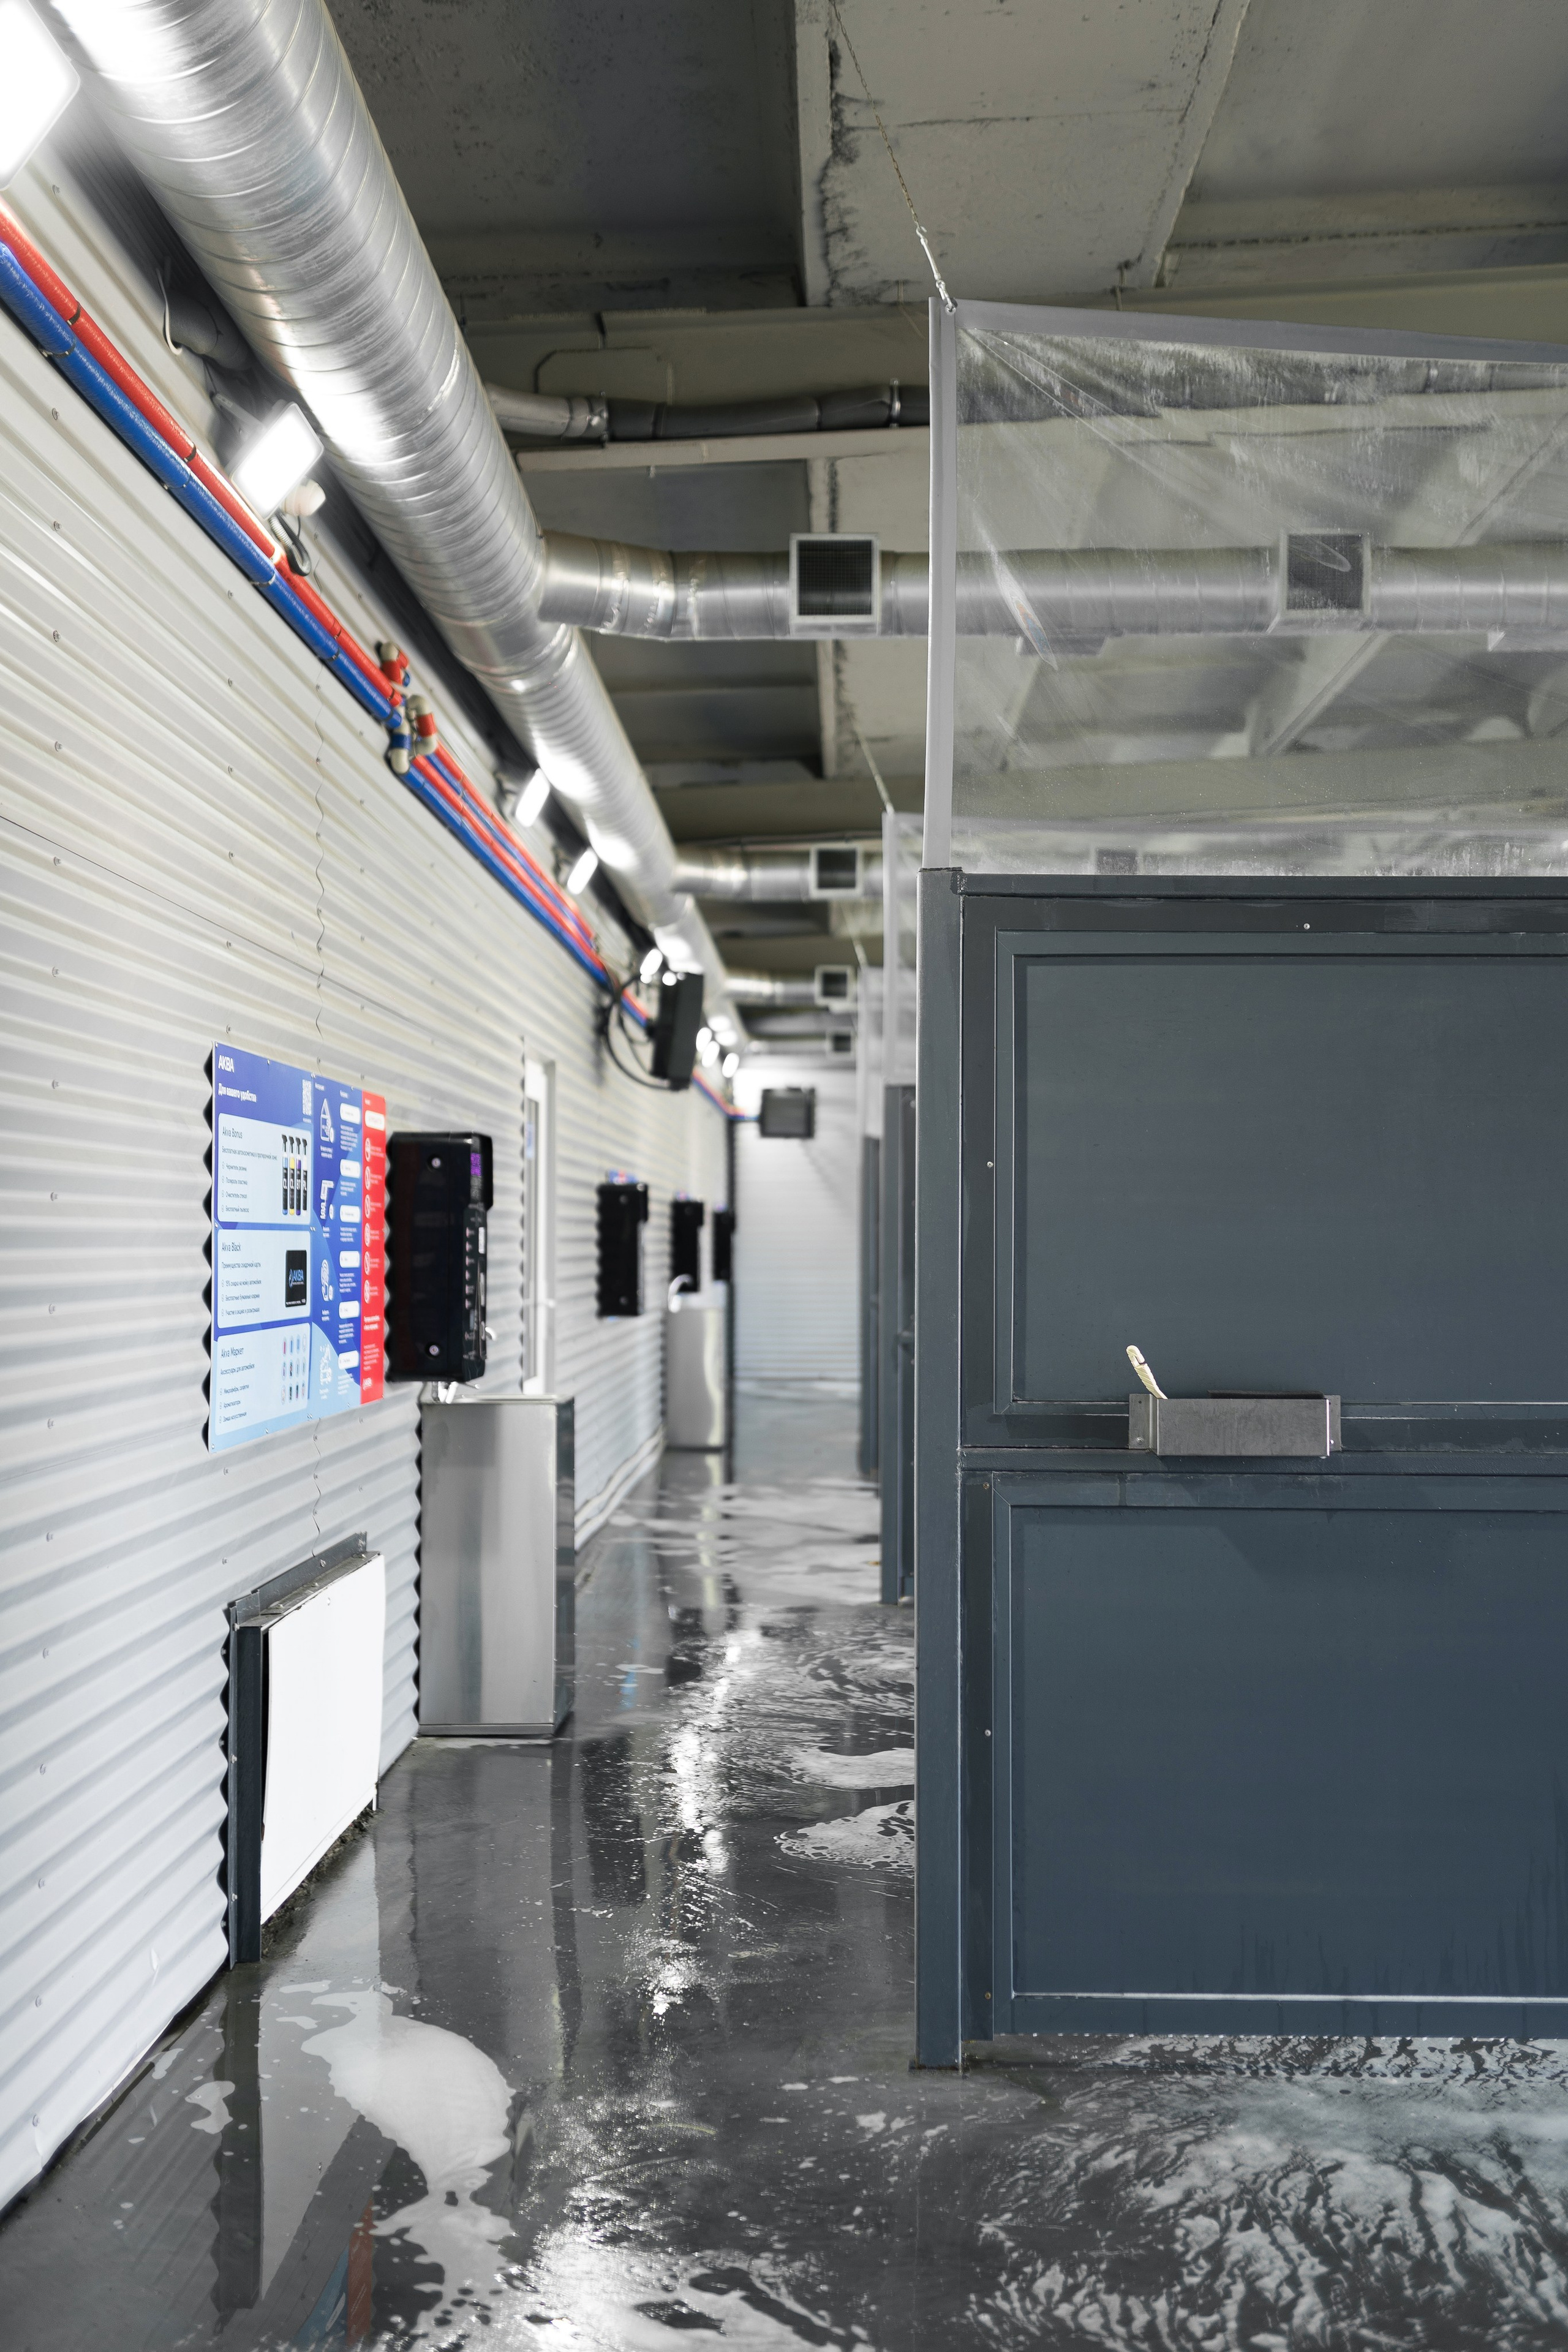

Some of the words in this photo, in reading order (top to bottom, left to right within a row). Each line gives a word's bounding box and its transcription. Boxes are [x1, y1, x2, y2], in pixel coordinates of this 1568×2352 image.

[218, 1055, 235, 1073] АКВА
[227, 1087, 240, 1099] вашего
[240, 1090, 257, 1102] удобства
[222, 1126, 231, 1137] Akva
[232, 1128, 243, 1139] Bonus
[221, 1242, 231, 1251] Akva
[232, 1242, 241, 1251] Black
[221, 1349, 230, 1358] Akva
[230, 1347, 244, 1357] Маркет
